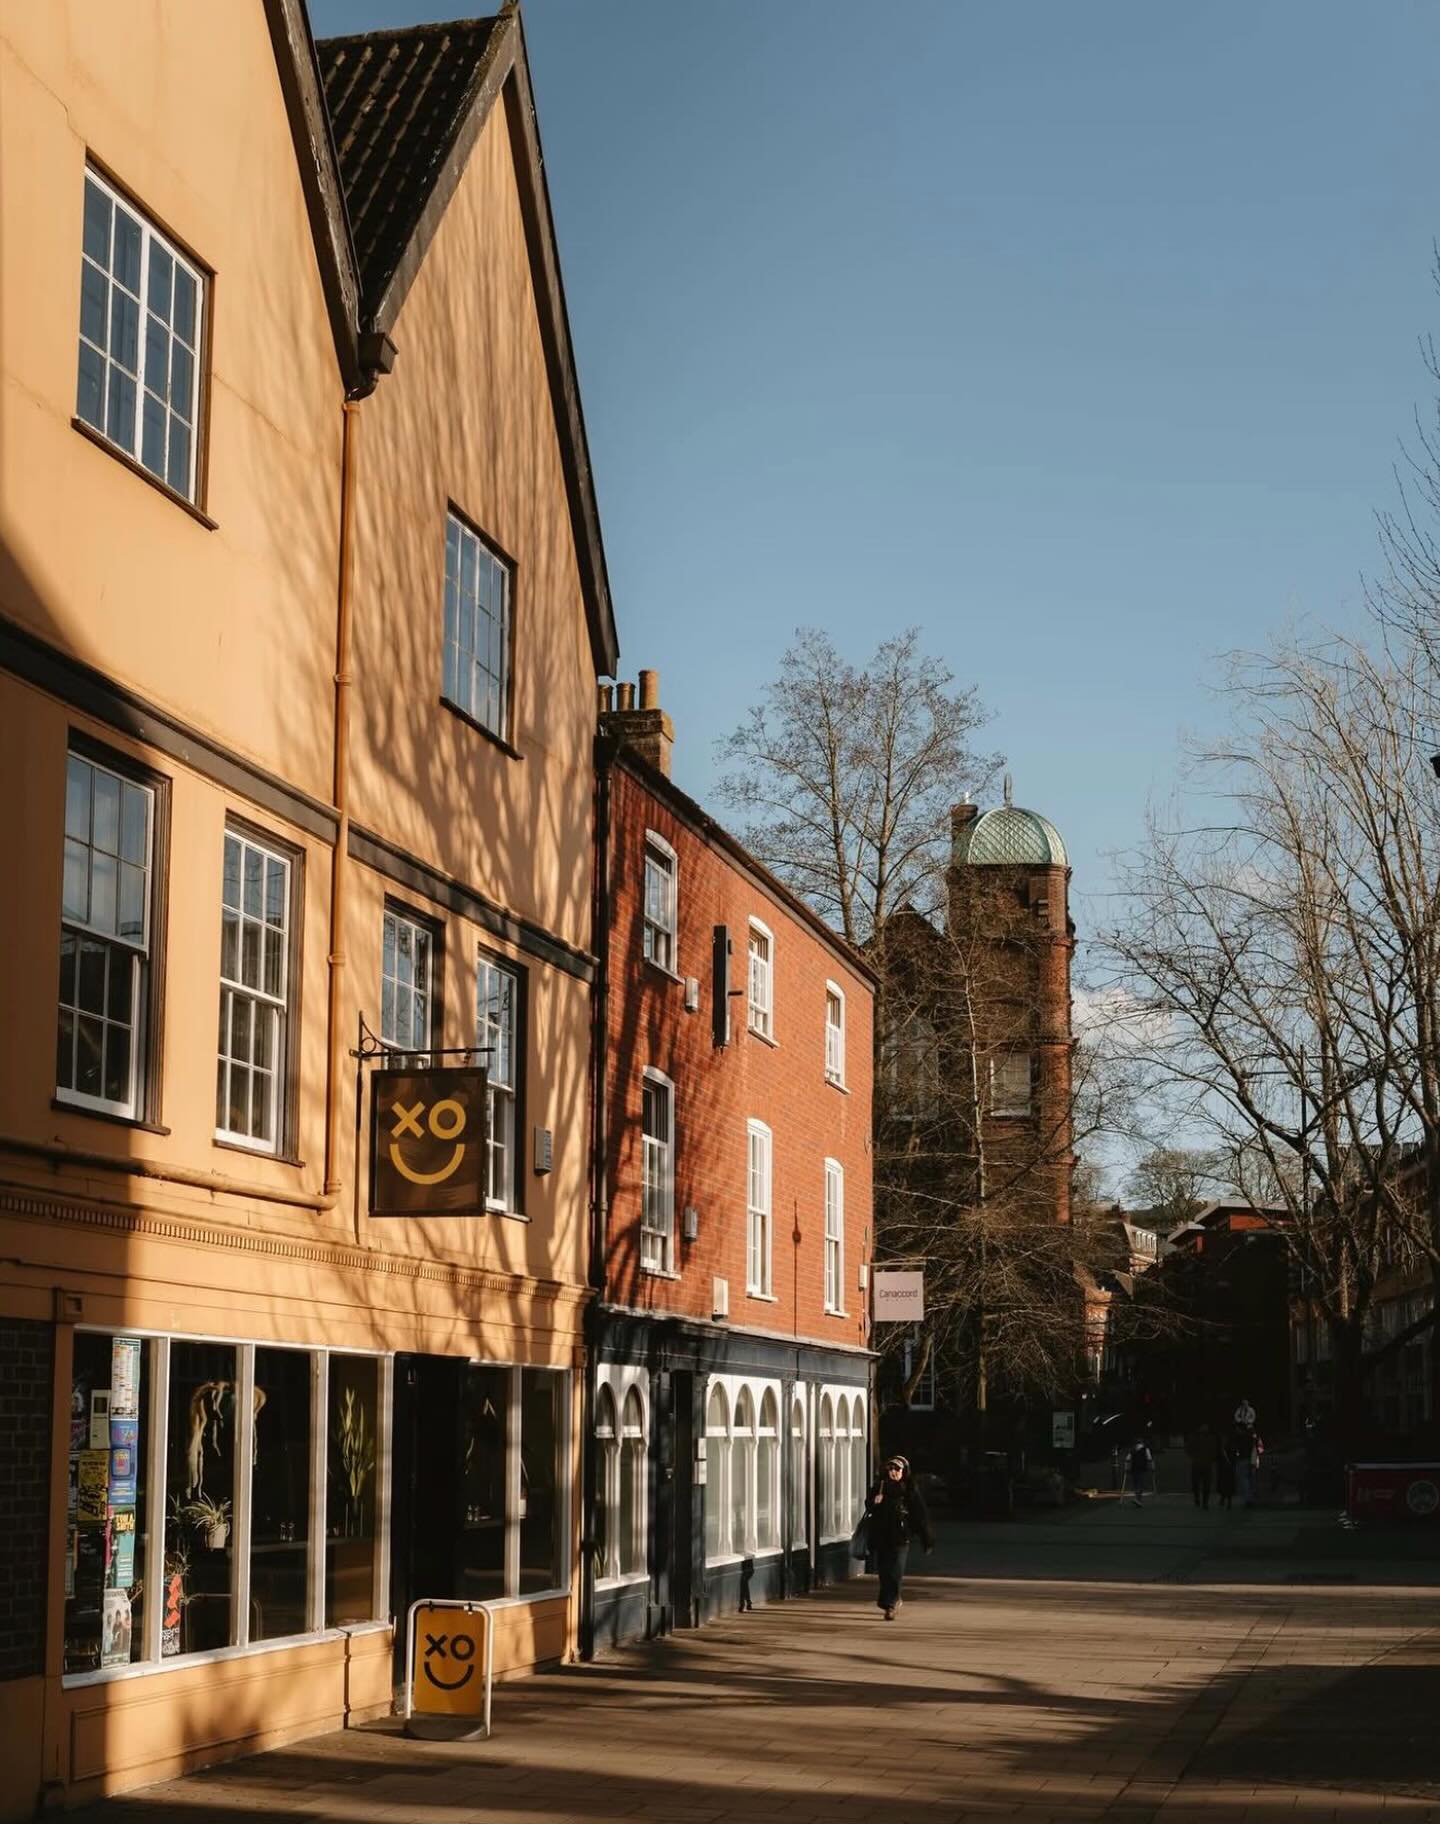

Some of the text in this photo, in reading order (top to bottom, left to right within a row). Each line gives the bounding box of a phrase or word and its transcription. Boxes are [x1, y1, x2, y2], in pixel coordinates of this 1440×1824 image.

[391, 1099, 466, 1139] XO
[879, 1289, 918, 1298] Canaccord
[425, 1634, 475, 1660] XO
